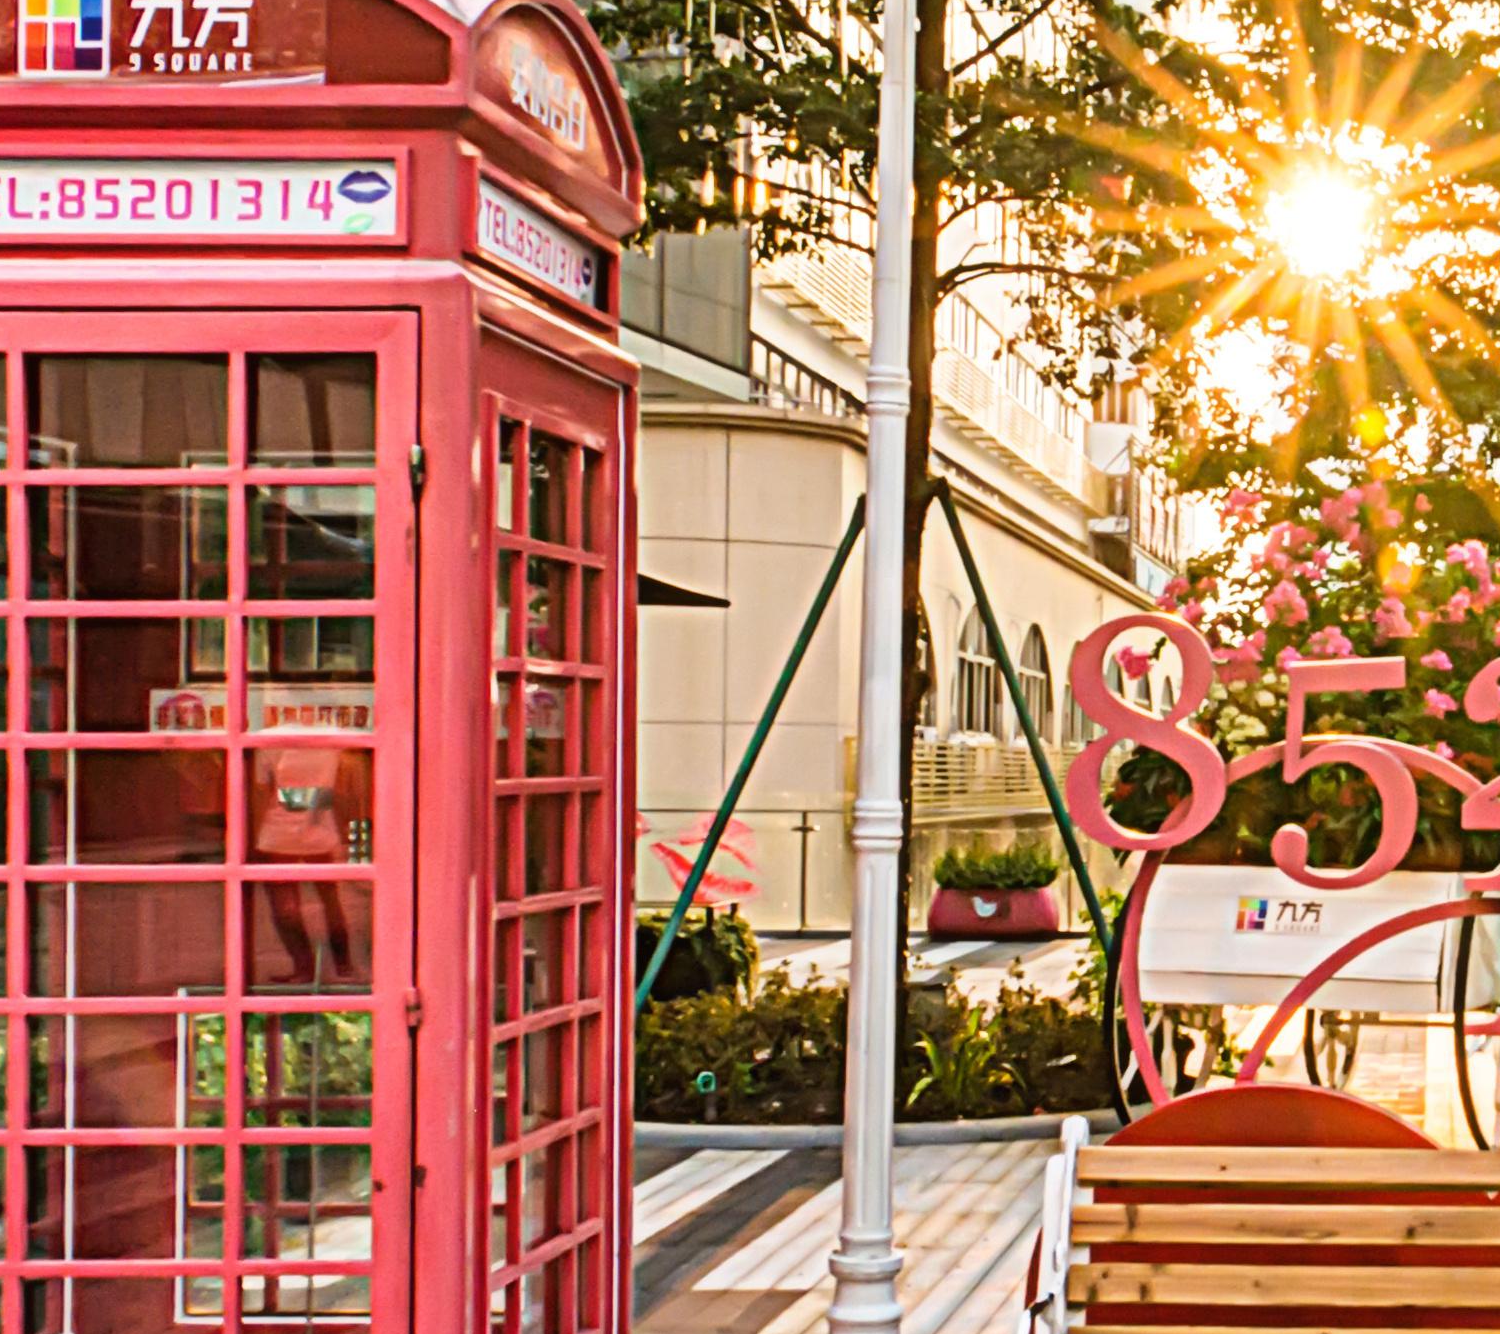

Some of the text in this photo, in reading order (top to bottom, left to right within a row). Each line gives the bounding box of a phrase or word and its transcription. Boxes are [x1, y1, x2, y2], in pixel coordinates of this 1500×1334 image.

[129, 52, 253, 74] 9 SQUARE
[1276, 899, 1324, 924] 九方
